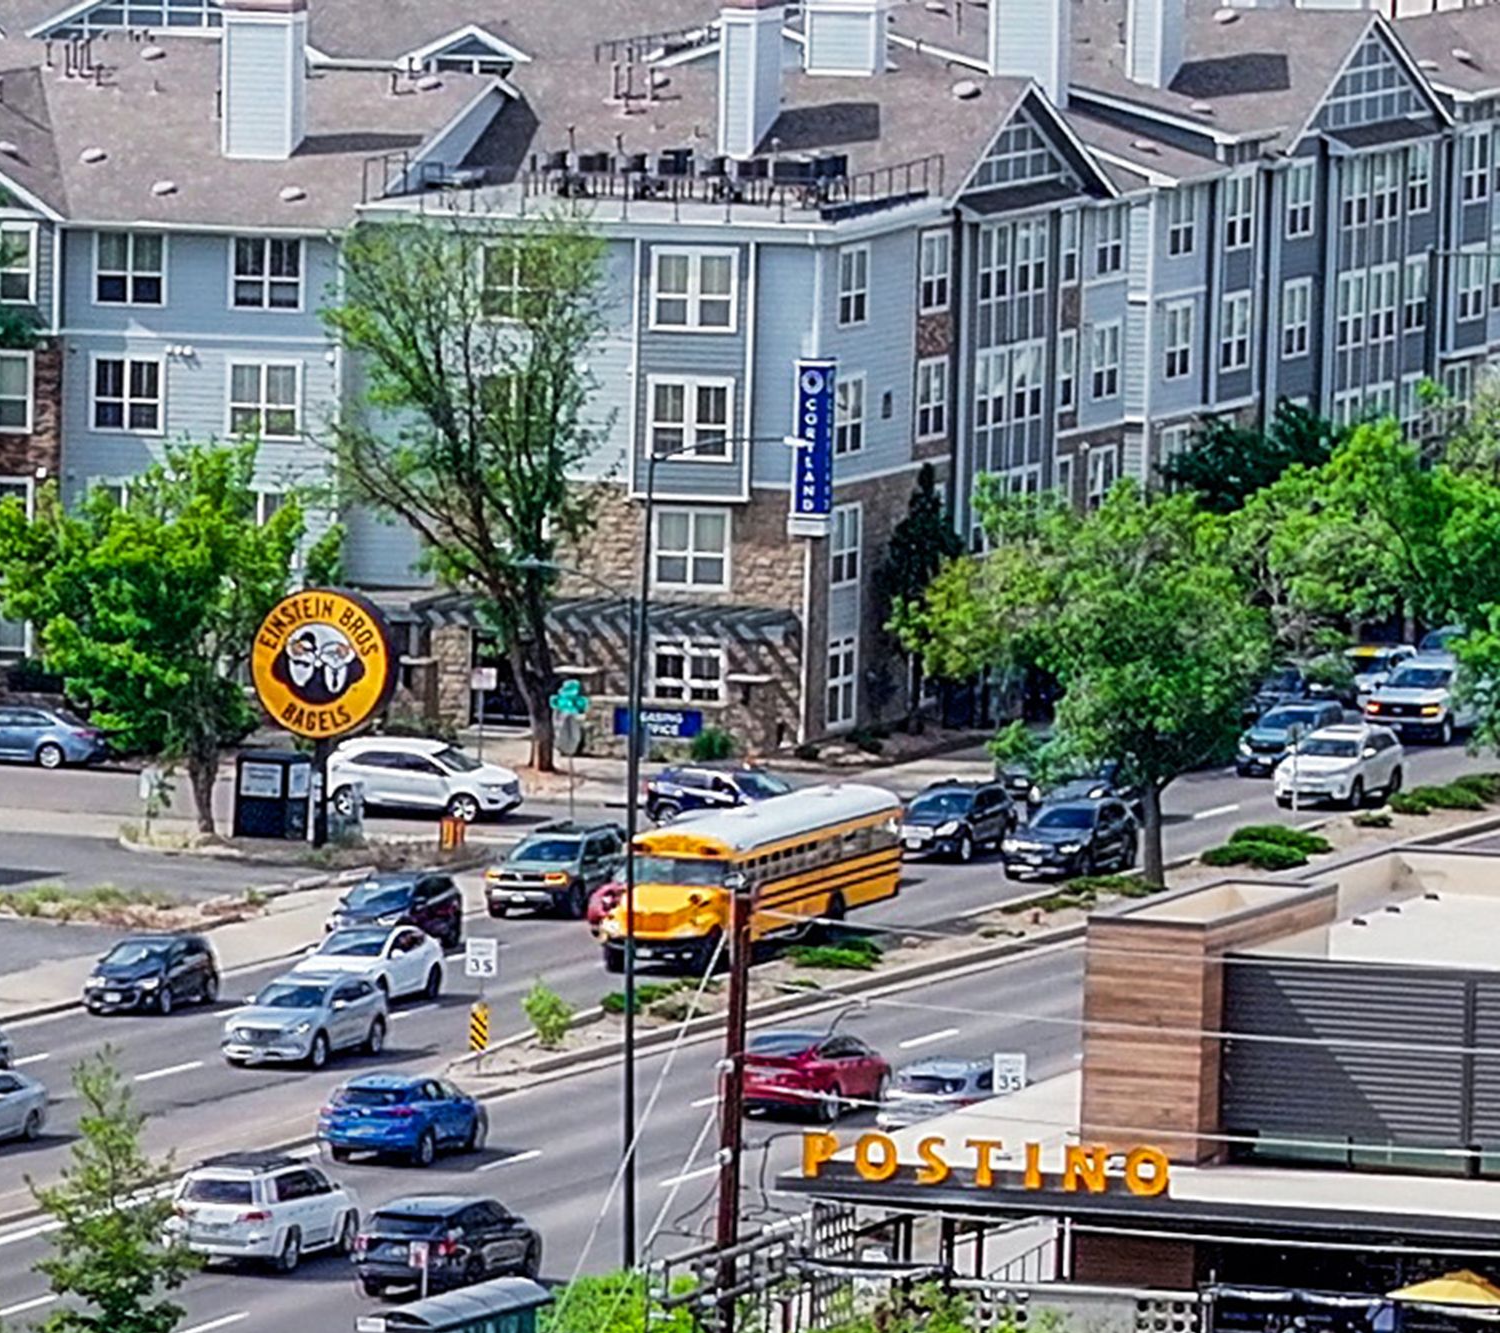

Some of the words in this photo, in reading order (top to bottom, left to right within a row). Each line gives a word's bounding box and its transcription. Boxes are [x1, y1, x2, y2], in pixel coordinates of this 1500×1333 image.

[801, 398, 819, 512] CORTLAND
[258, 596, 335, 650] EINSTEIN
[338, 606, 379, 657] BROS
[281, 701, 353, 732] BAGELS
[638, 710, 684, 725] EASING
[470, 958, 493, 973] 35
[998, 1075, 1022, 1091] 35
[801, 1129, 1170, 1196] POSTINO
